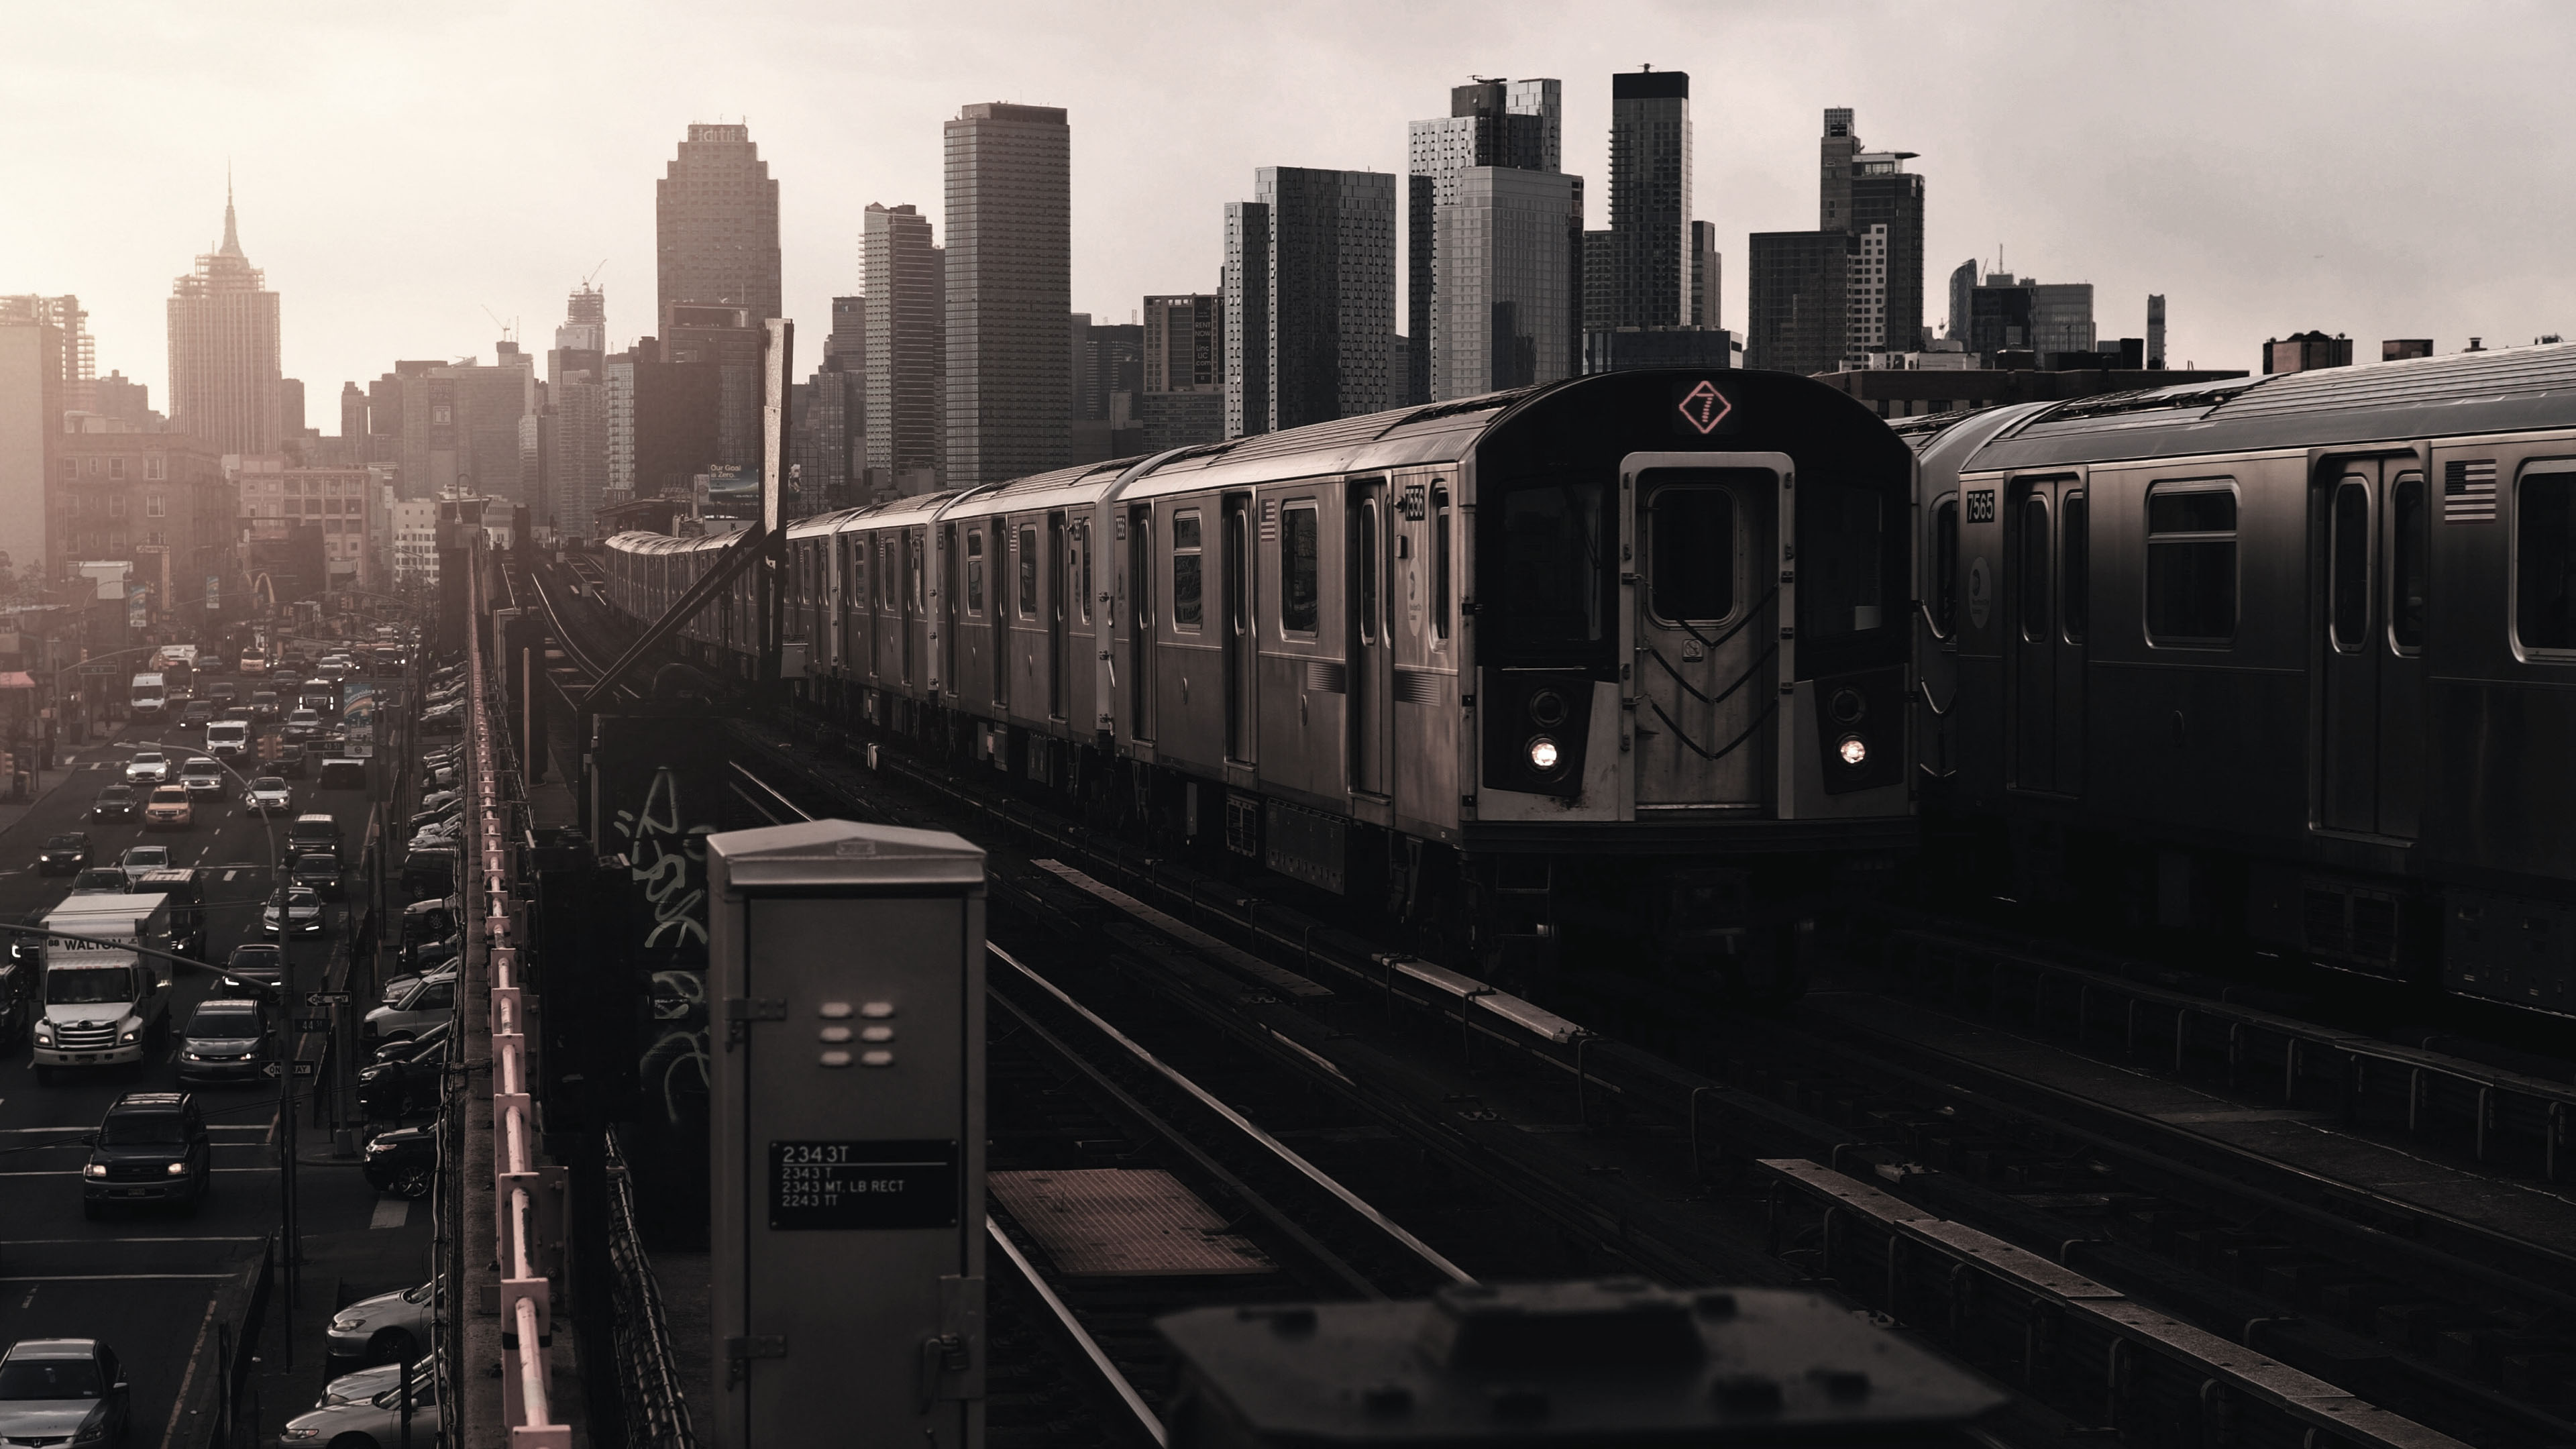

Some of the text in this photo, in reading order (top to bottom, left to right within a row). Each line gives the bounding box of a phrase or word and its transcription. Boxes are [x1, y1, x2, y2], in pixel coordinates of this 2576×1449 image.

[1695, 393, 1714, 423] 7
[1405, 488, 1424, 517] 7556
[1968, 492, 1993, 520] 7565
[302, 1020, 313, 1030] 44
[783, 1146, 849, 1163] 2343T
[782, 1167, 833, 1179] 2343 T
[782, 1181, 820, 1193] 2343
[850, 1181, 867, 1192] LB
[871, 1180, 904, 1192] RECT
[782, 1194, 838, 1207] 2243 TT
